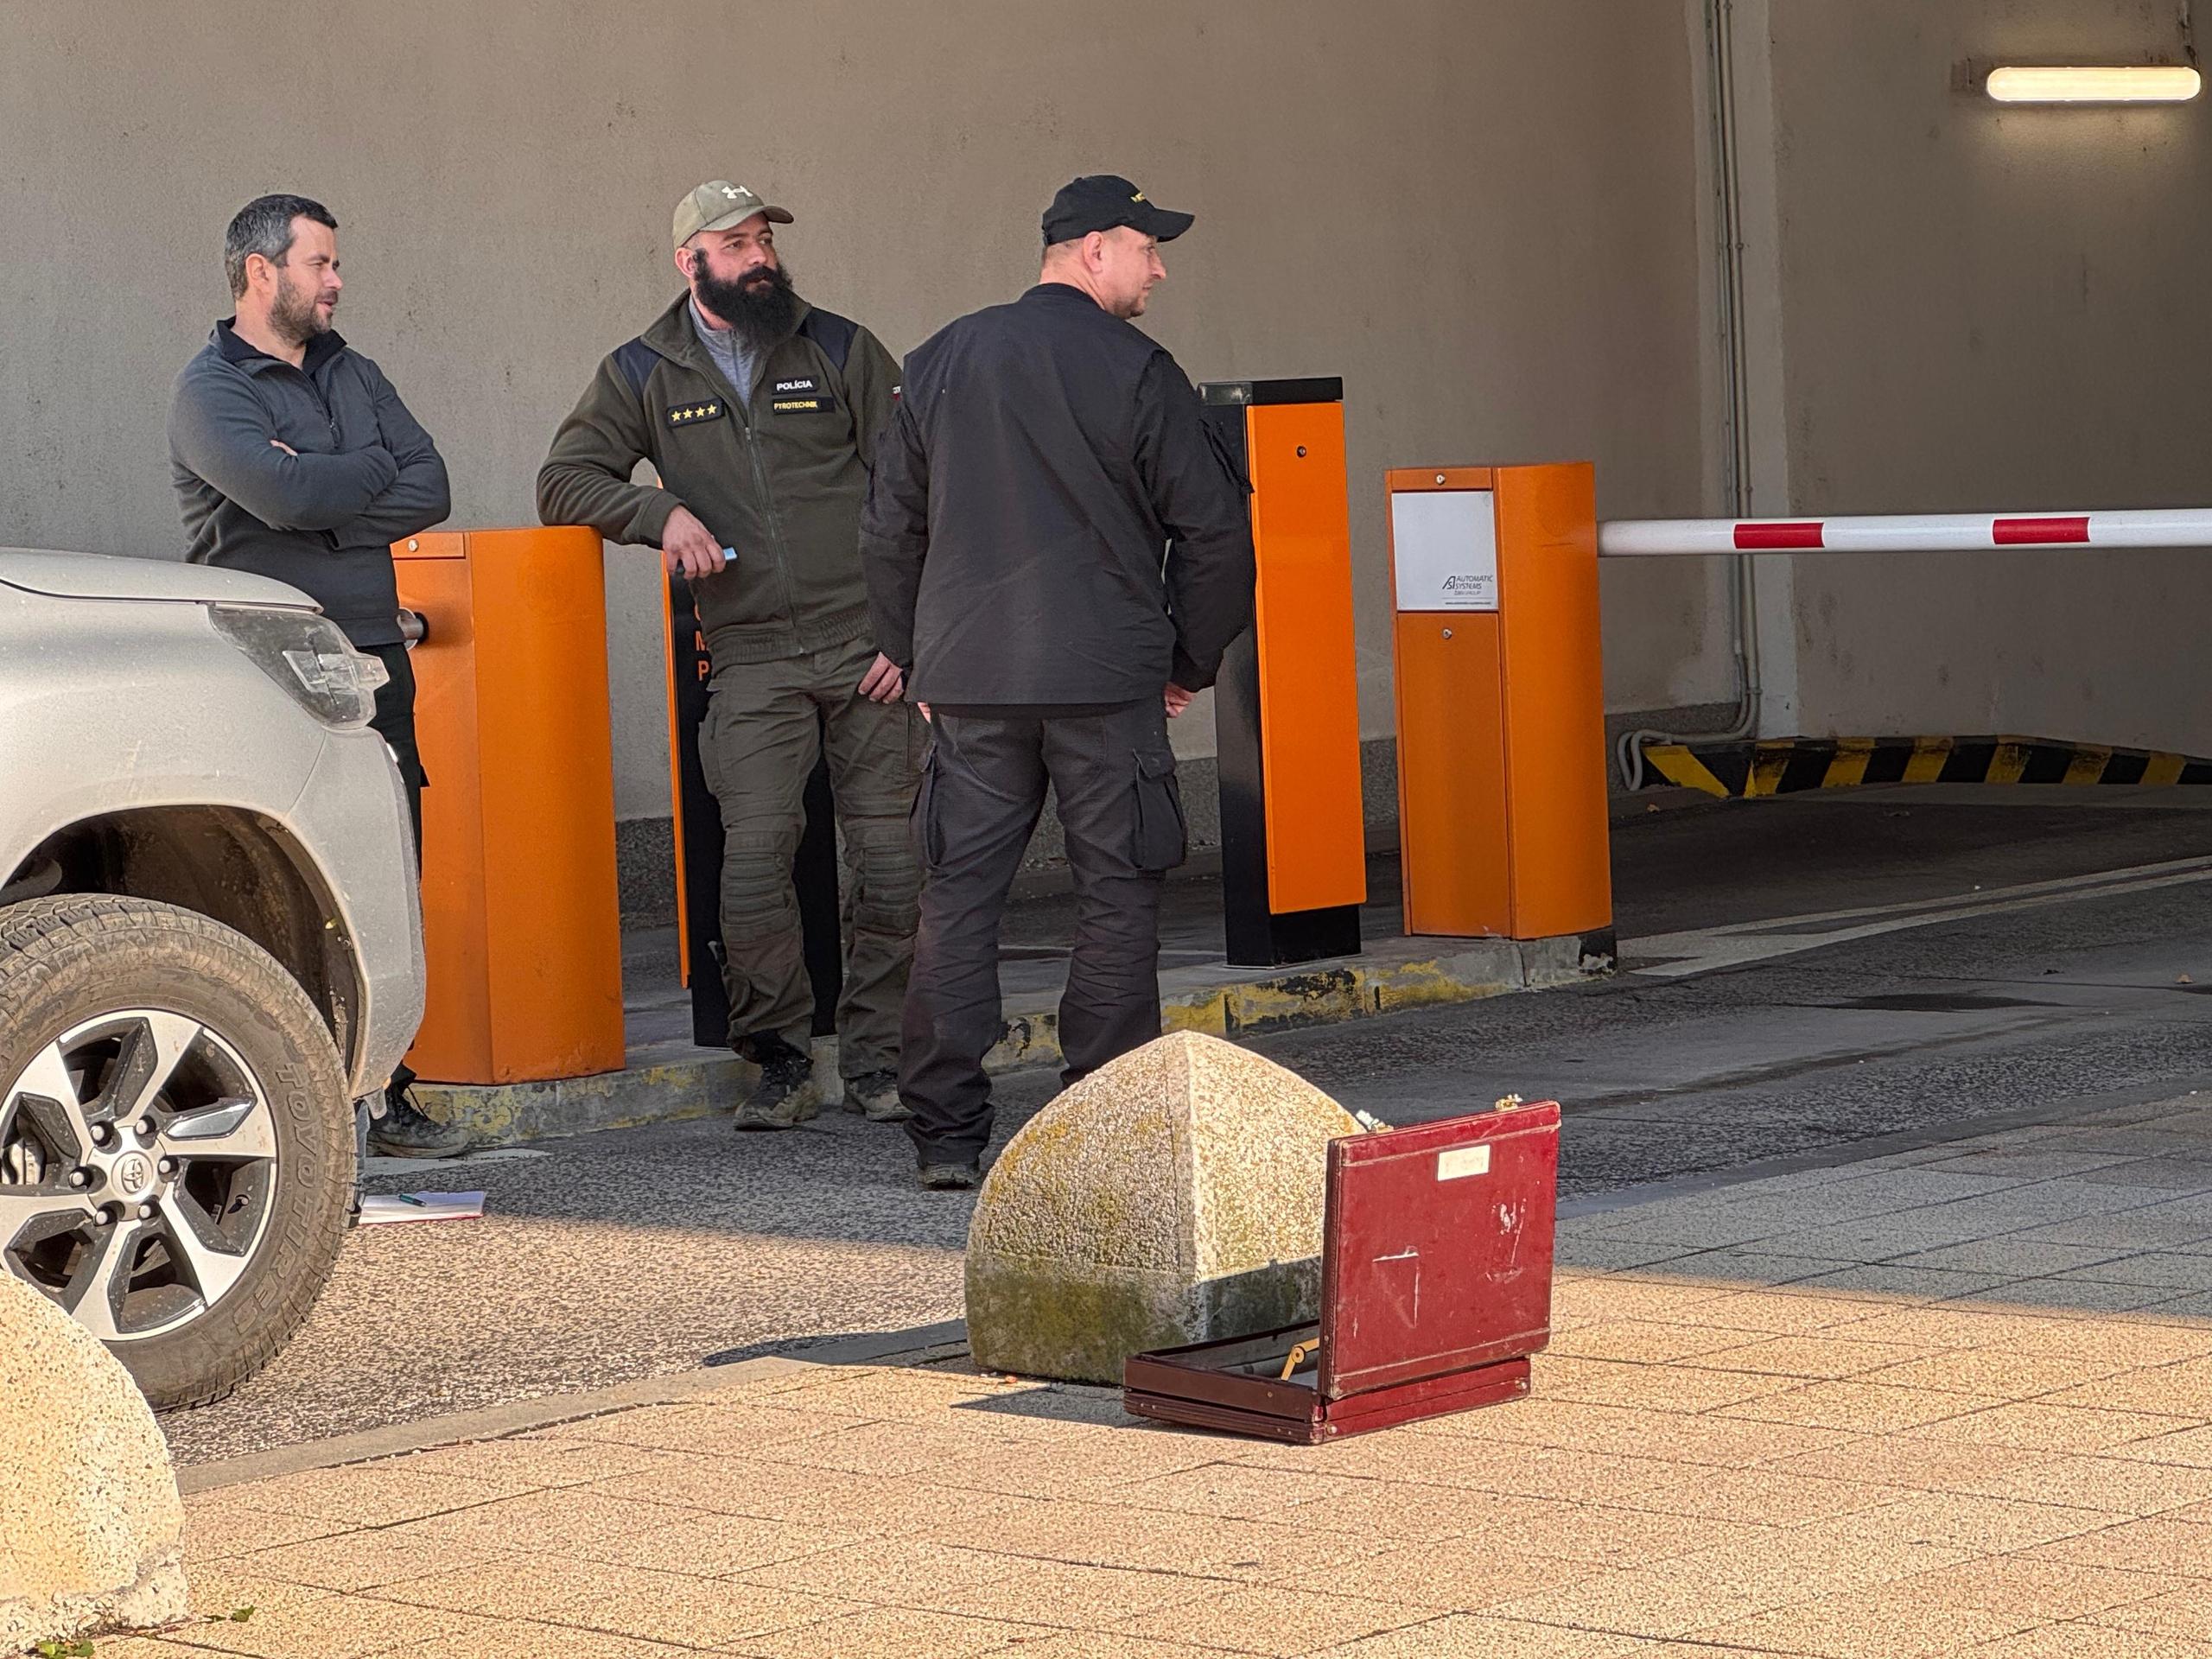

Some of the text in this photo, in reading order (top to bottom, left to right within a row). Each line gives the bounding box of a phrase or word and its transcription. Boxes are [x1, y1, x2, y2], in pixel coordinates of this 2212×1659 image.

[777, 380, 813, 391] POLÍCIA
[233, 1063, 317, 1335] TOYO TIRES
